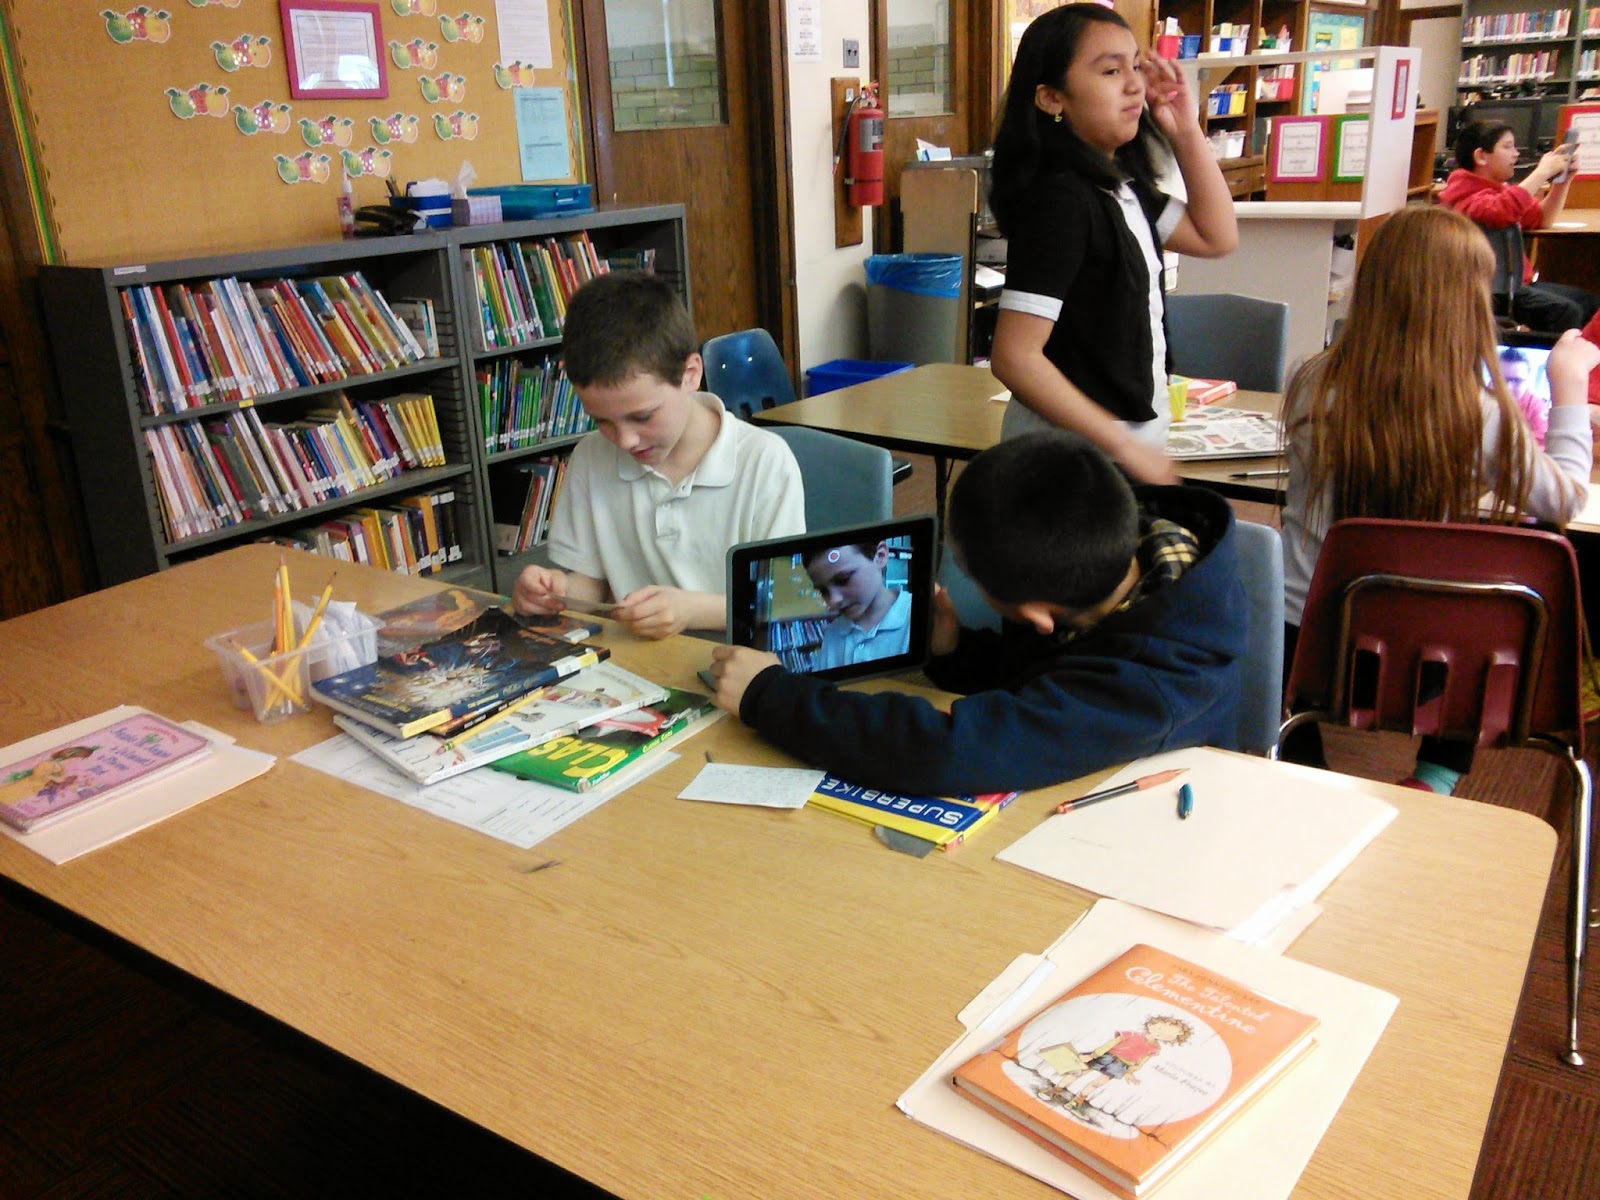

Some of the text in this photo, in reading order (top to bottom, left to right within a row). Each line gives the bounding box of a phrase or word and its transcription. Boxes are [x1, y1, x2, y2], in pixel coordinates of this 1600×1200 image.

[820, 776, 964, 826] SUPERBIKE
[1125, 966, 1256, 1034] Clementine
[1168, 972, 1271, 1022] The Talented
